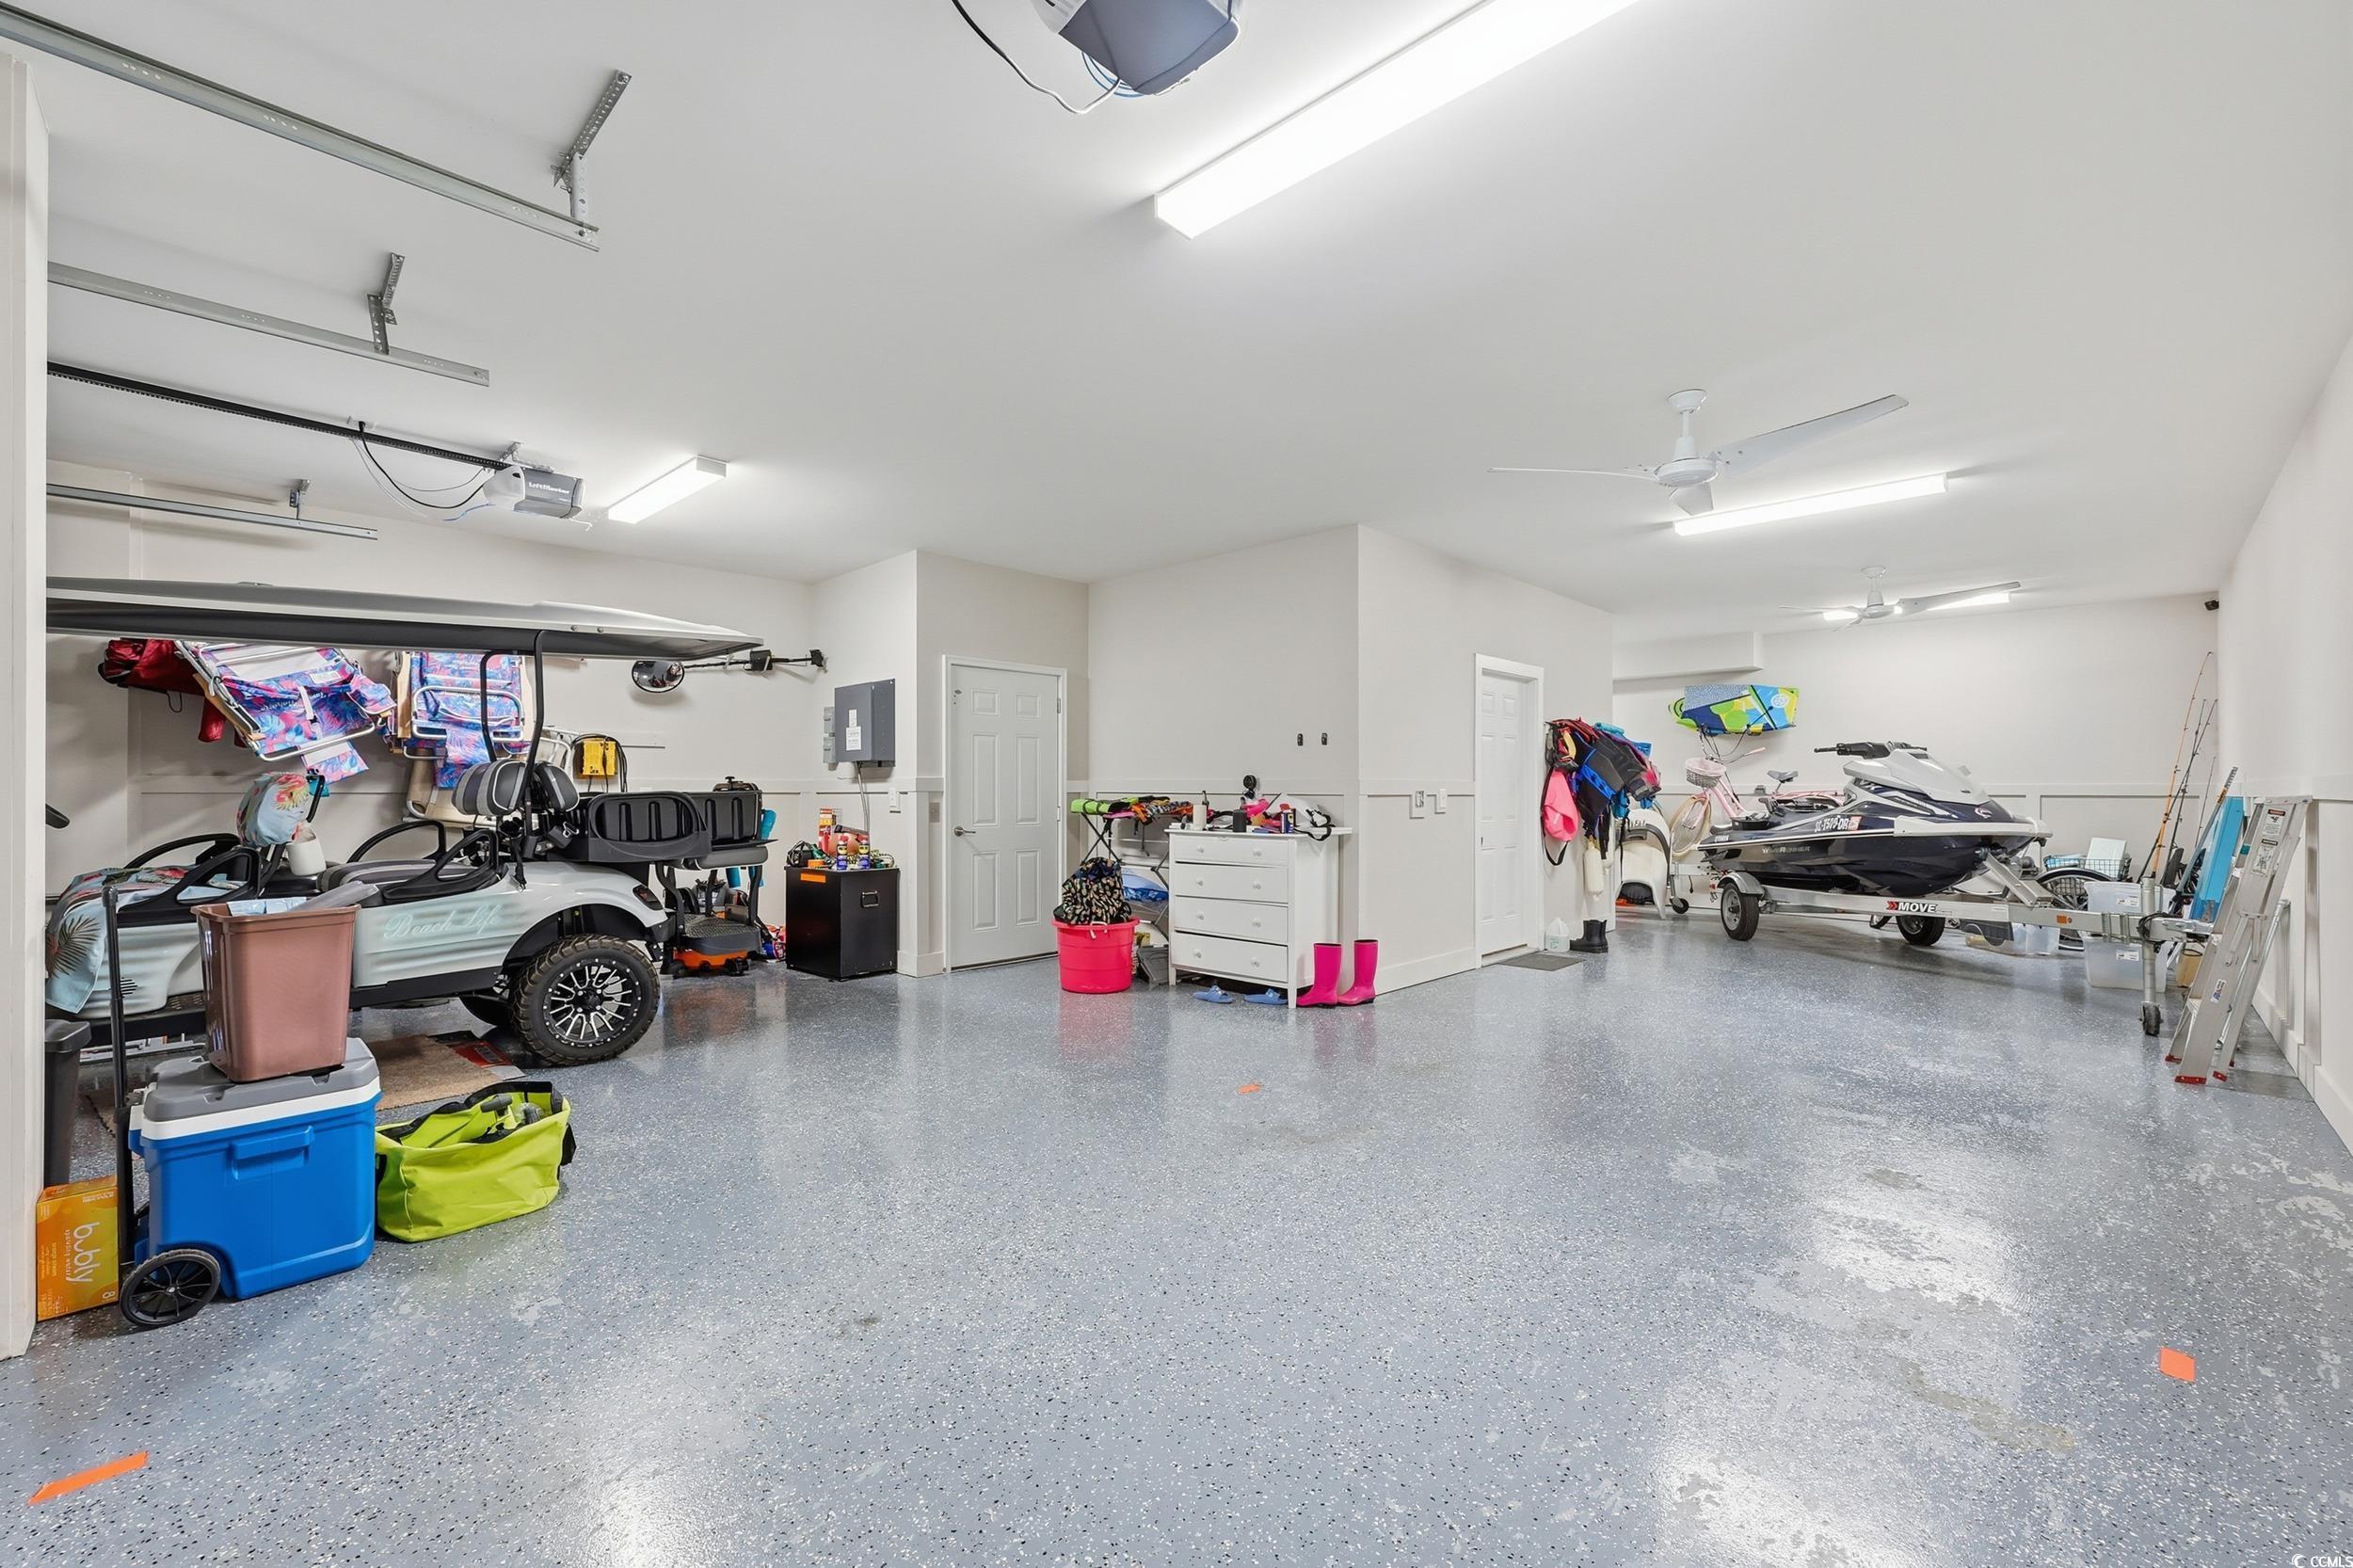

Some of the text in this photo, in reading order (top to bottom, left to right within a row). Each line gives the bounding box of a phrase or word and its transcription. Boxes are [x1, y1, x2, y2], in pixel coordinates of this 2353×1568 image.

[1897, 902, 1938, 913] MOVE
[384, 904, 503, 939] Beach Life
[66, 1222, 102, 1282] bubly
[102, 1290, 116, 1299] 8
